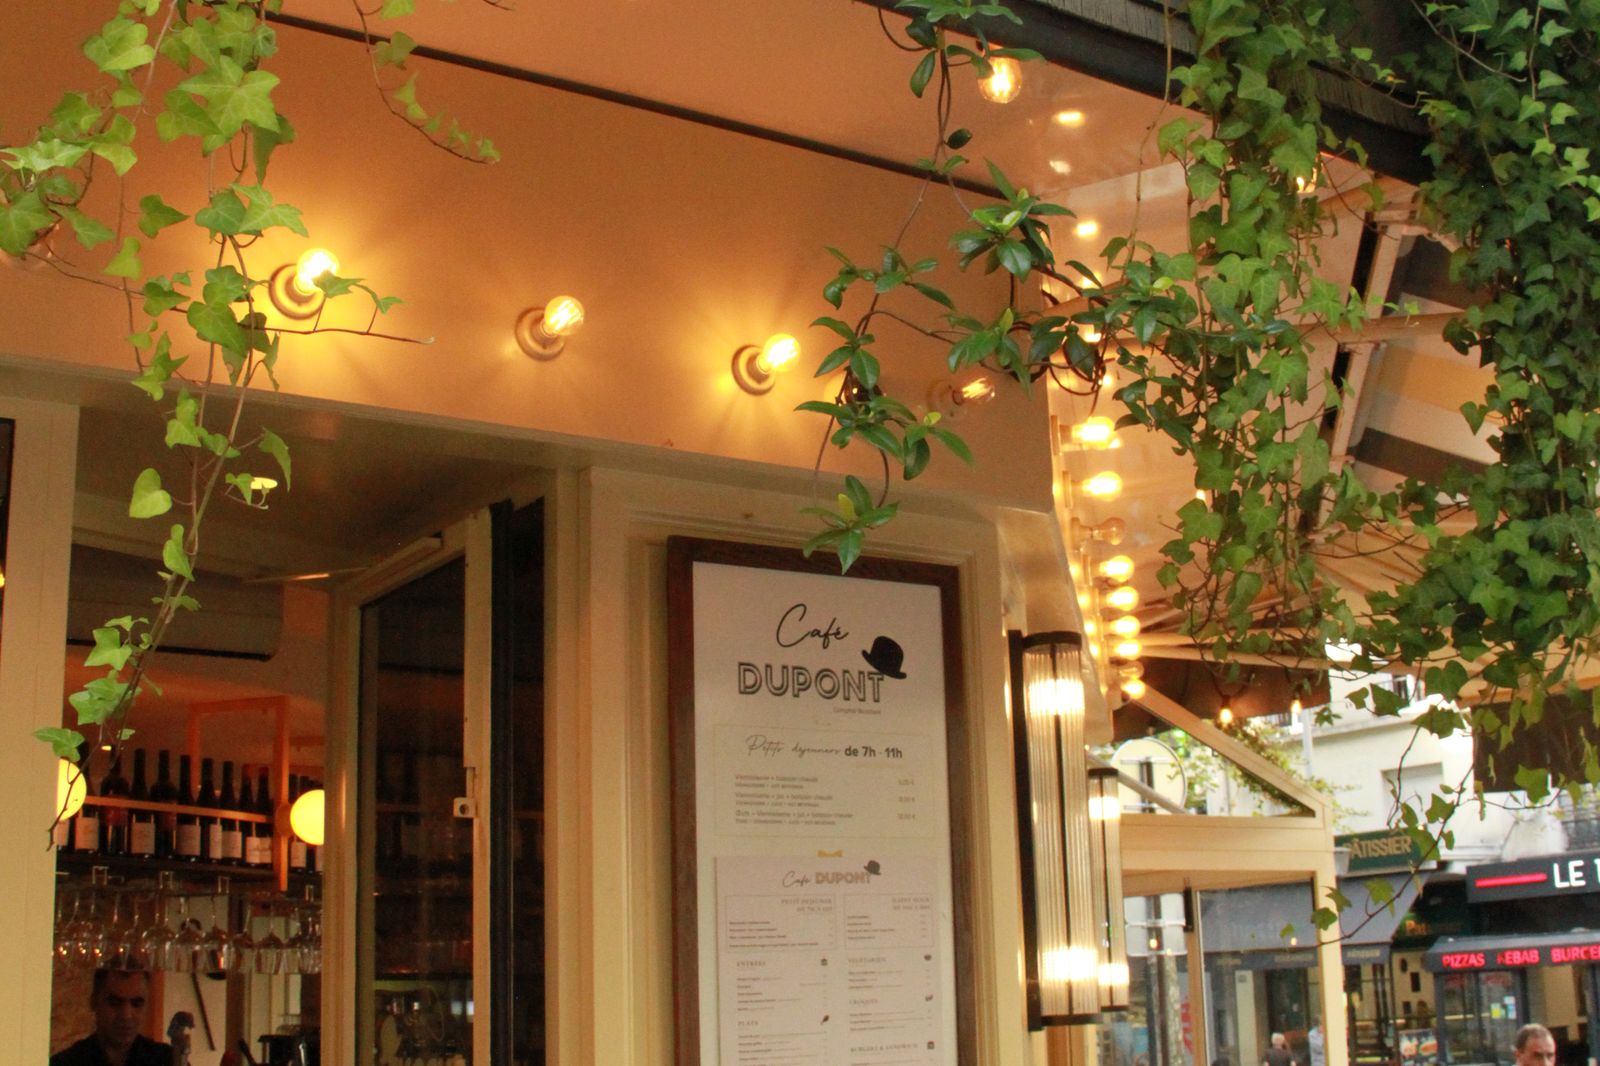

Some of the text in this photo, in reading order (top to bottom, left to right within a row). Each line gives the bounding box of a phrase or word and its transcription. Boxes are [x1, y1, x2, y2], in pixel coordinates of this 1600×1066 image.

[776, 603, 849, 650] Café
[737, 661, 886, 703] DUPONT
[844, 745, 858, 757] de
[862, 746, 876, 758] 7h
[884, 747, 903, 759] 11h
[815, 872, 870, 884] DUPONT
[1553, 860, 1587, 888] LE
[1441, 952, 1486, 969] PIZZAS
